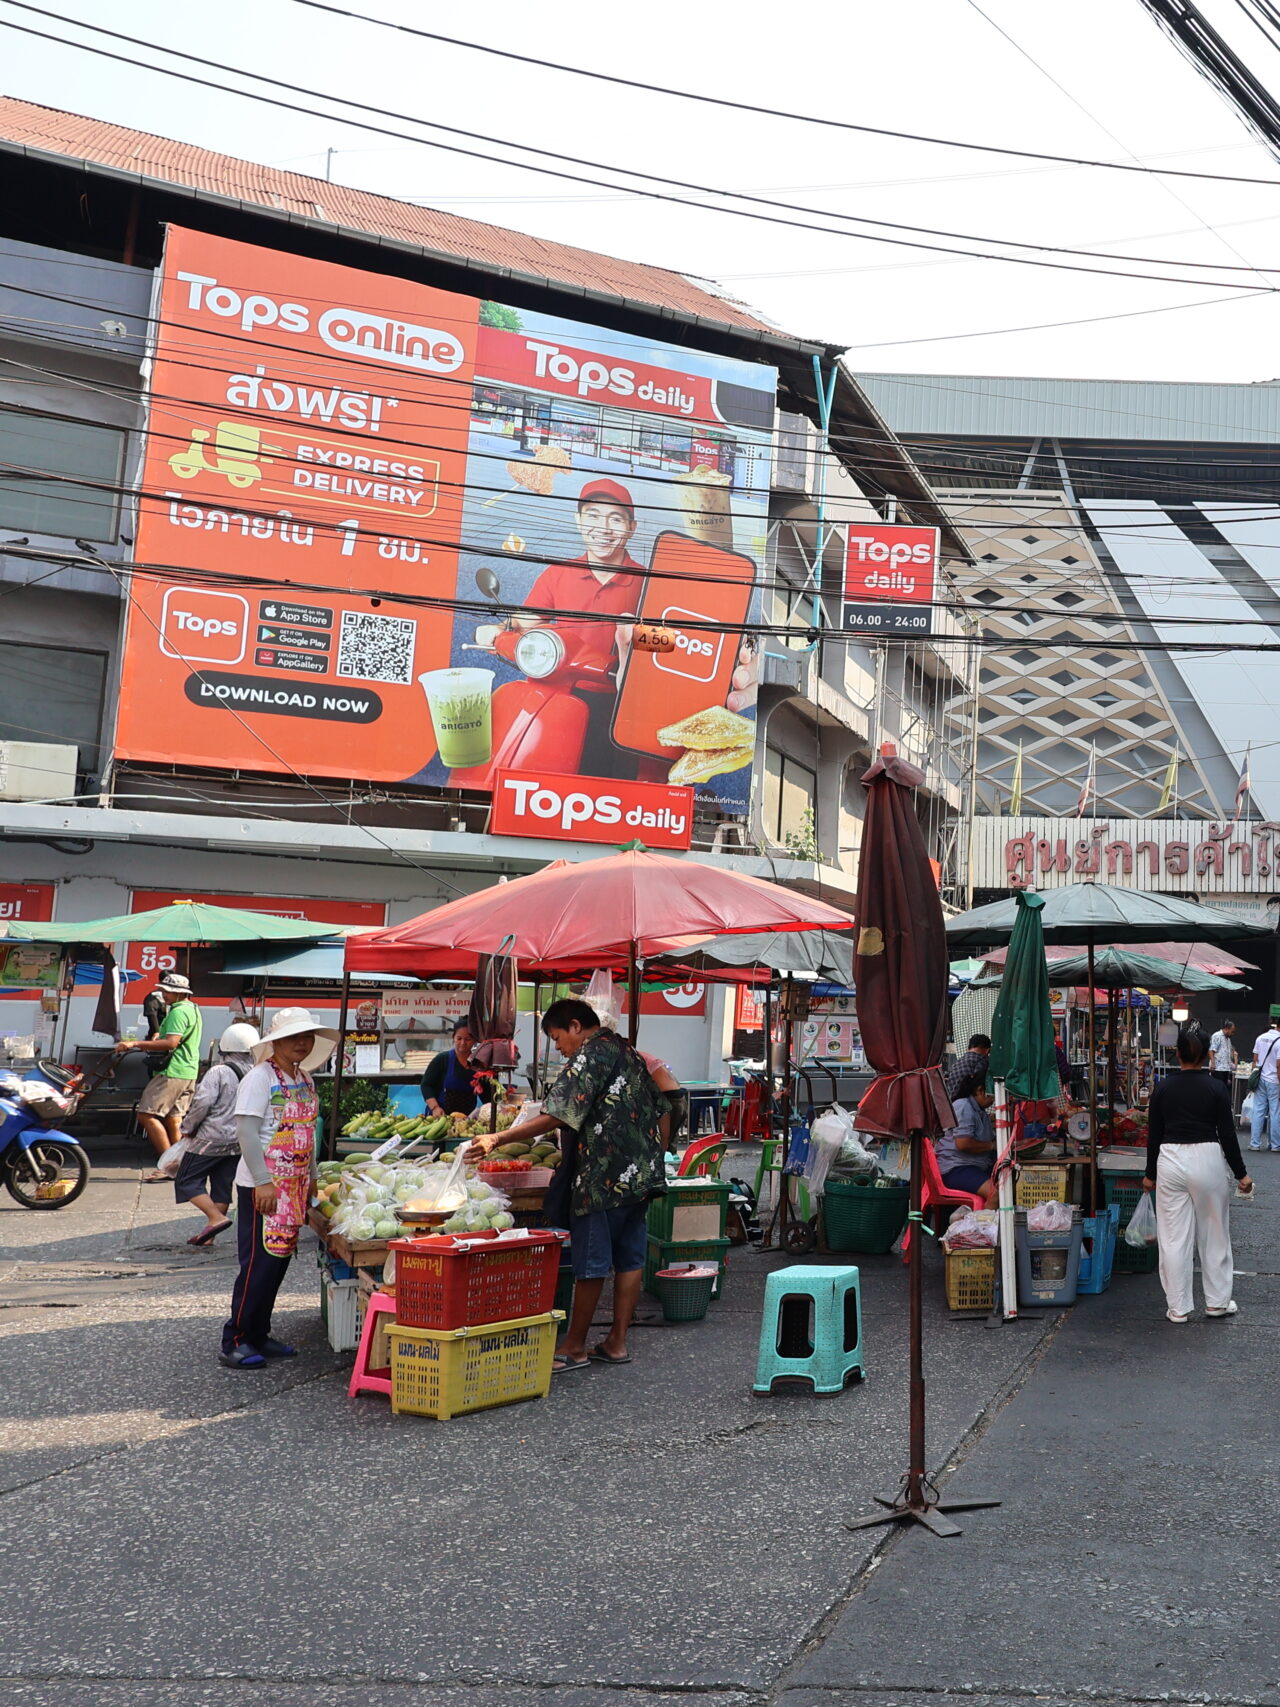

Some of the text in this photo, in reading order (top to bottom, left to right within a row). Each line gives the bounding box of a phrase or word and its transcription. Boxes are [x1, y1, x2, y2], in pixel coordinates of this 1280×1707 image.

[177, 271, 310, 332] Tops
[526, 340, 696, 414] Tops daily
[296, 444, 424, 484] EXPRESS
[293, 469, 425, 507] DELIVERY
[336, 519, 361, 556] 1
[851, 536, 931, 569] Tops
[864, 571, 915, 594] daily
[280, 610, 328, 626] App Store
[281, 604, 307, 613] Download
[850, 614, 882, 626] 06.00
[895, 616, 927, 627] 24:00
[172, 610, 238, 638] Tops
[279, 635, 327, 650] Google Play
[638, 632, 670, 647] 4.50
[277, 657, 325, 671] AppGallery
[200, 683, 370, 715] DOWNLOAD NOW
[504, 780, 686, 835] Tops daily
[398, 1341, 440, 1362] แมน-ผลไม้
